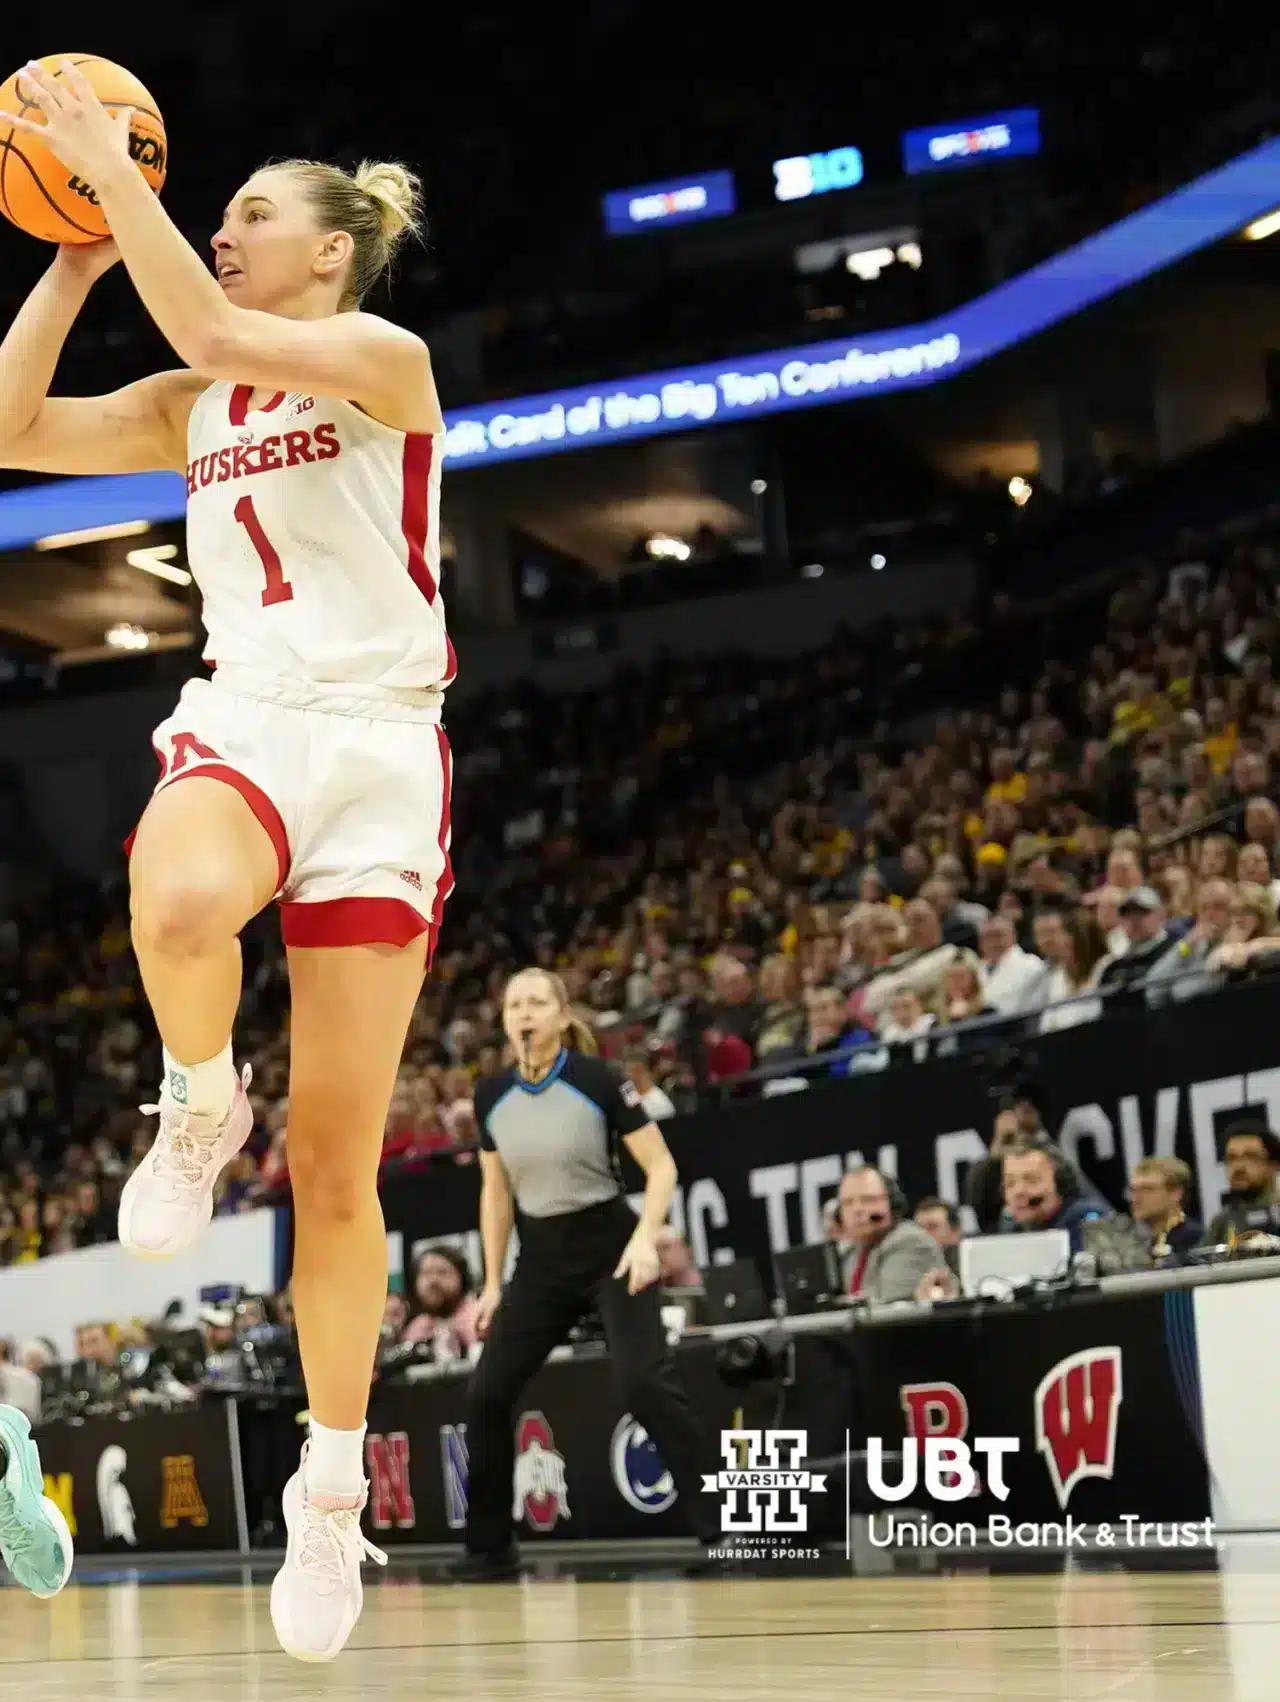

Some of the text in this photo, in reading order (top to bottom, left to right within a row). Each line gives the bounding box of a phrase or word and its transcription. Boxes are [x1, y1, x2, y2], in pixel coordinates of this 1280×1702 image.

[187, 422, 341, 498] HUSKERS
[233, 495, 294, 608] 1
[366, 1431, 416, 1529] N
[1034, 1346, 1123, 1511] W
